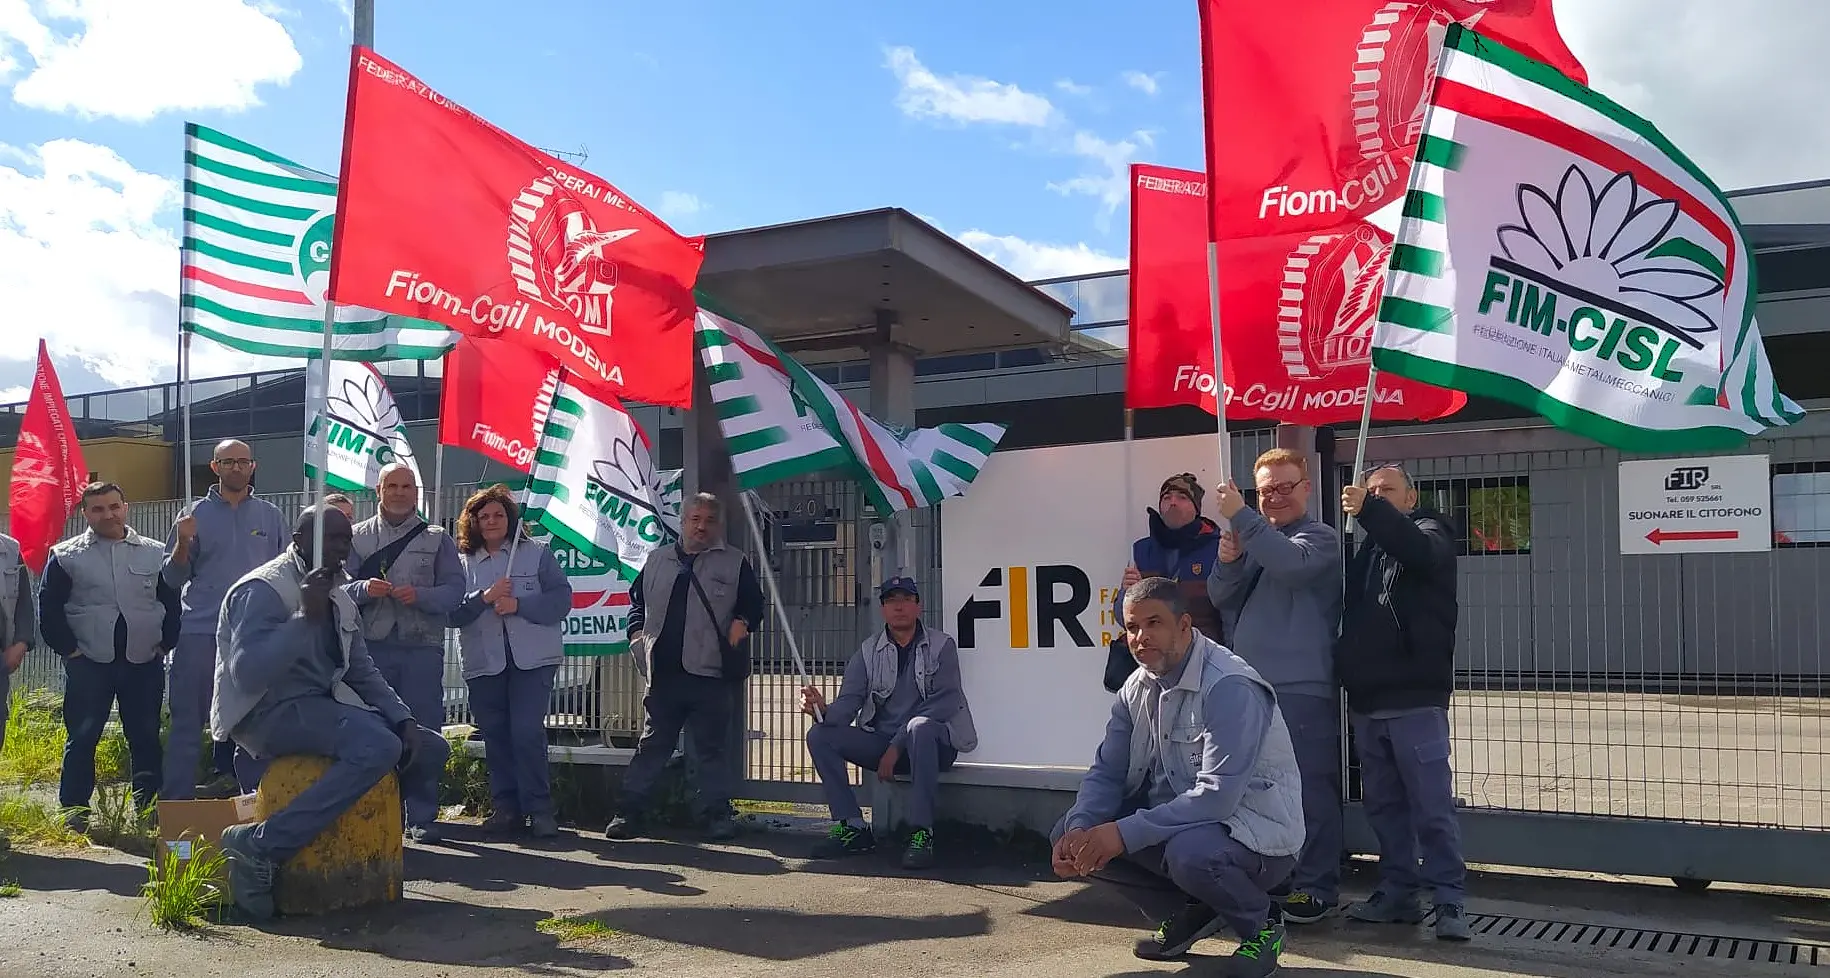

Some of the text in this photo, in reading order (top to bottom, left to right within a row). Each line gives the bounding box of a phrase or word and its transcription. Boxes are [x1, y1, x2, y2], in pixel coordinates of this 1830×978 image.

[1258, 154, 1398, 219] Fiom-Cgil
[385, 269, 625, 387] Fiom-Cgil MODENA
[1477, 270, 1684, 383] FIM-CISL
[1302, 387, 1404, 411] MODENA
[1665, 466, 1709, 491] FIR
[585, 482, 665, 543] FIM-C
[1629, 507, 1762, 520] SUONARE IL CITOFONO
[957, 565, 1095, 648] FIR
